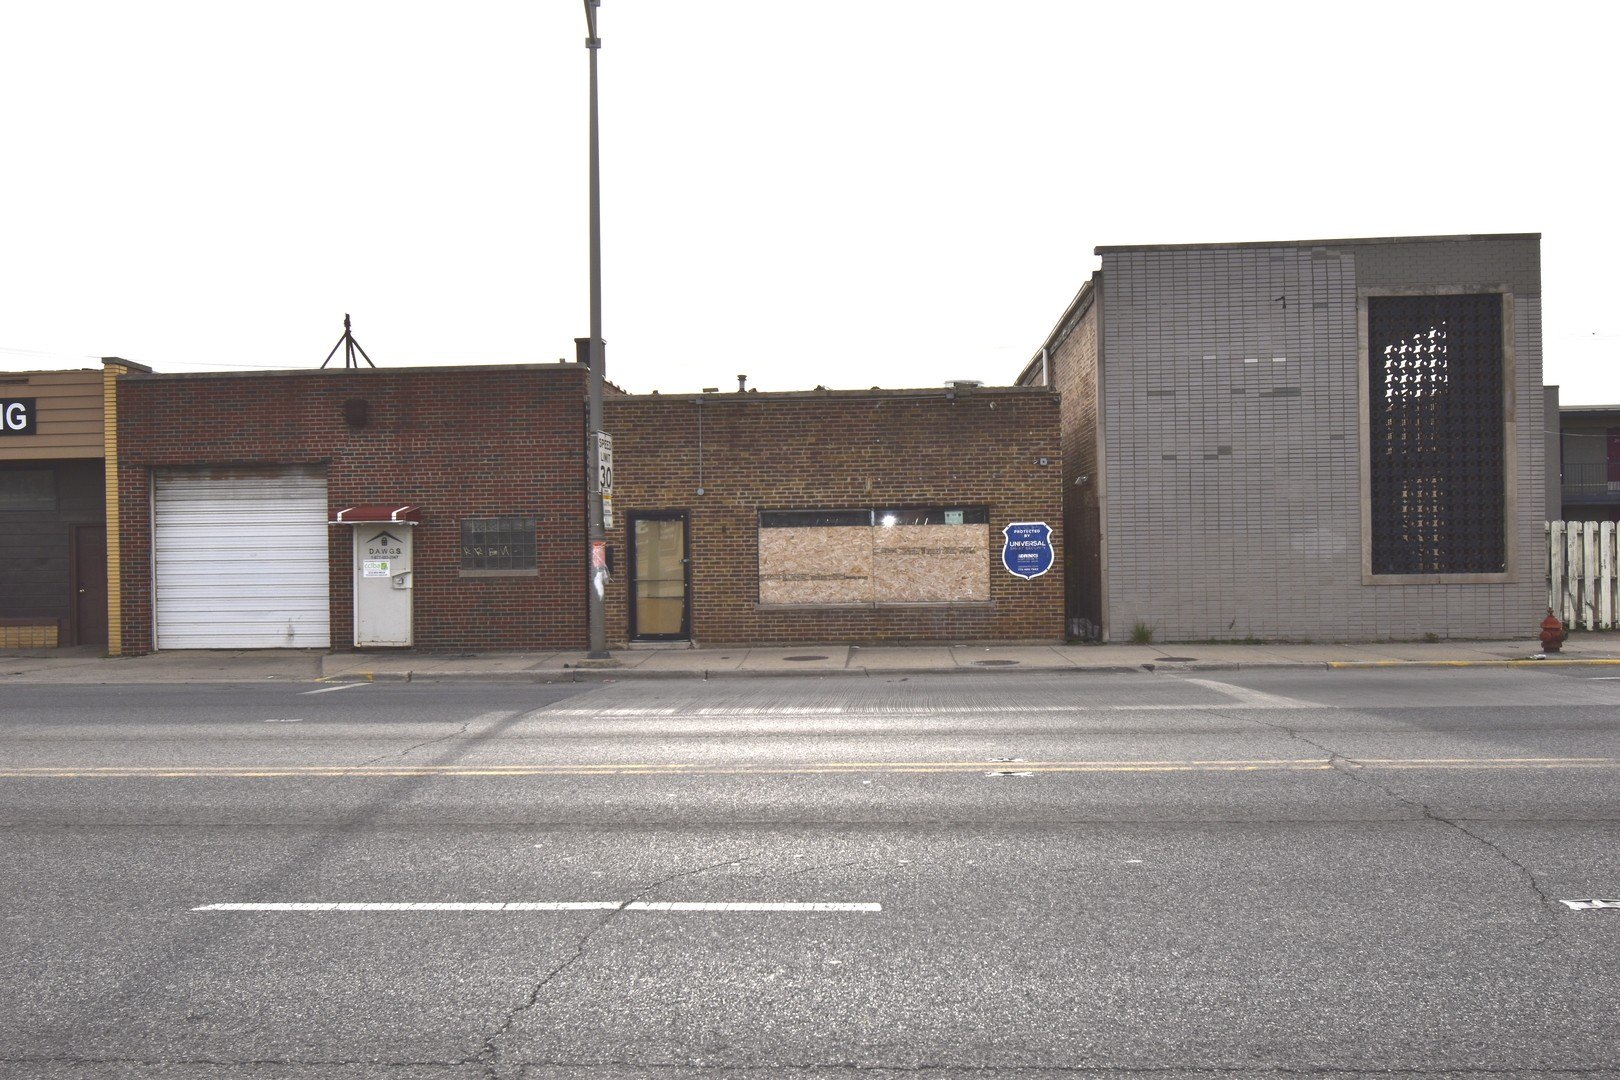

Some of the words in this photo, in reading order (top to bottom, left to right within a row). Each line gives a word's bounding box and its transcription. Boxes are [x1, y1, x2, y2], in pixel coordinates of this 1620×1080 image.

[0, 402, 27, 430] G
[599, 438, 612, 450] SPEED
[600, 451, 611, 463] LIMIT
[600, 465, 612, 487] 30
